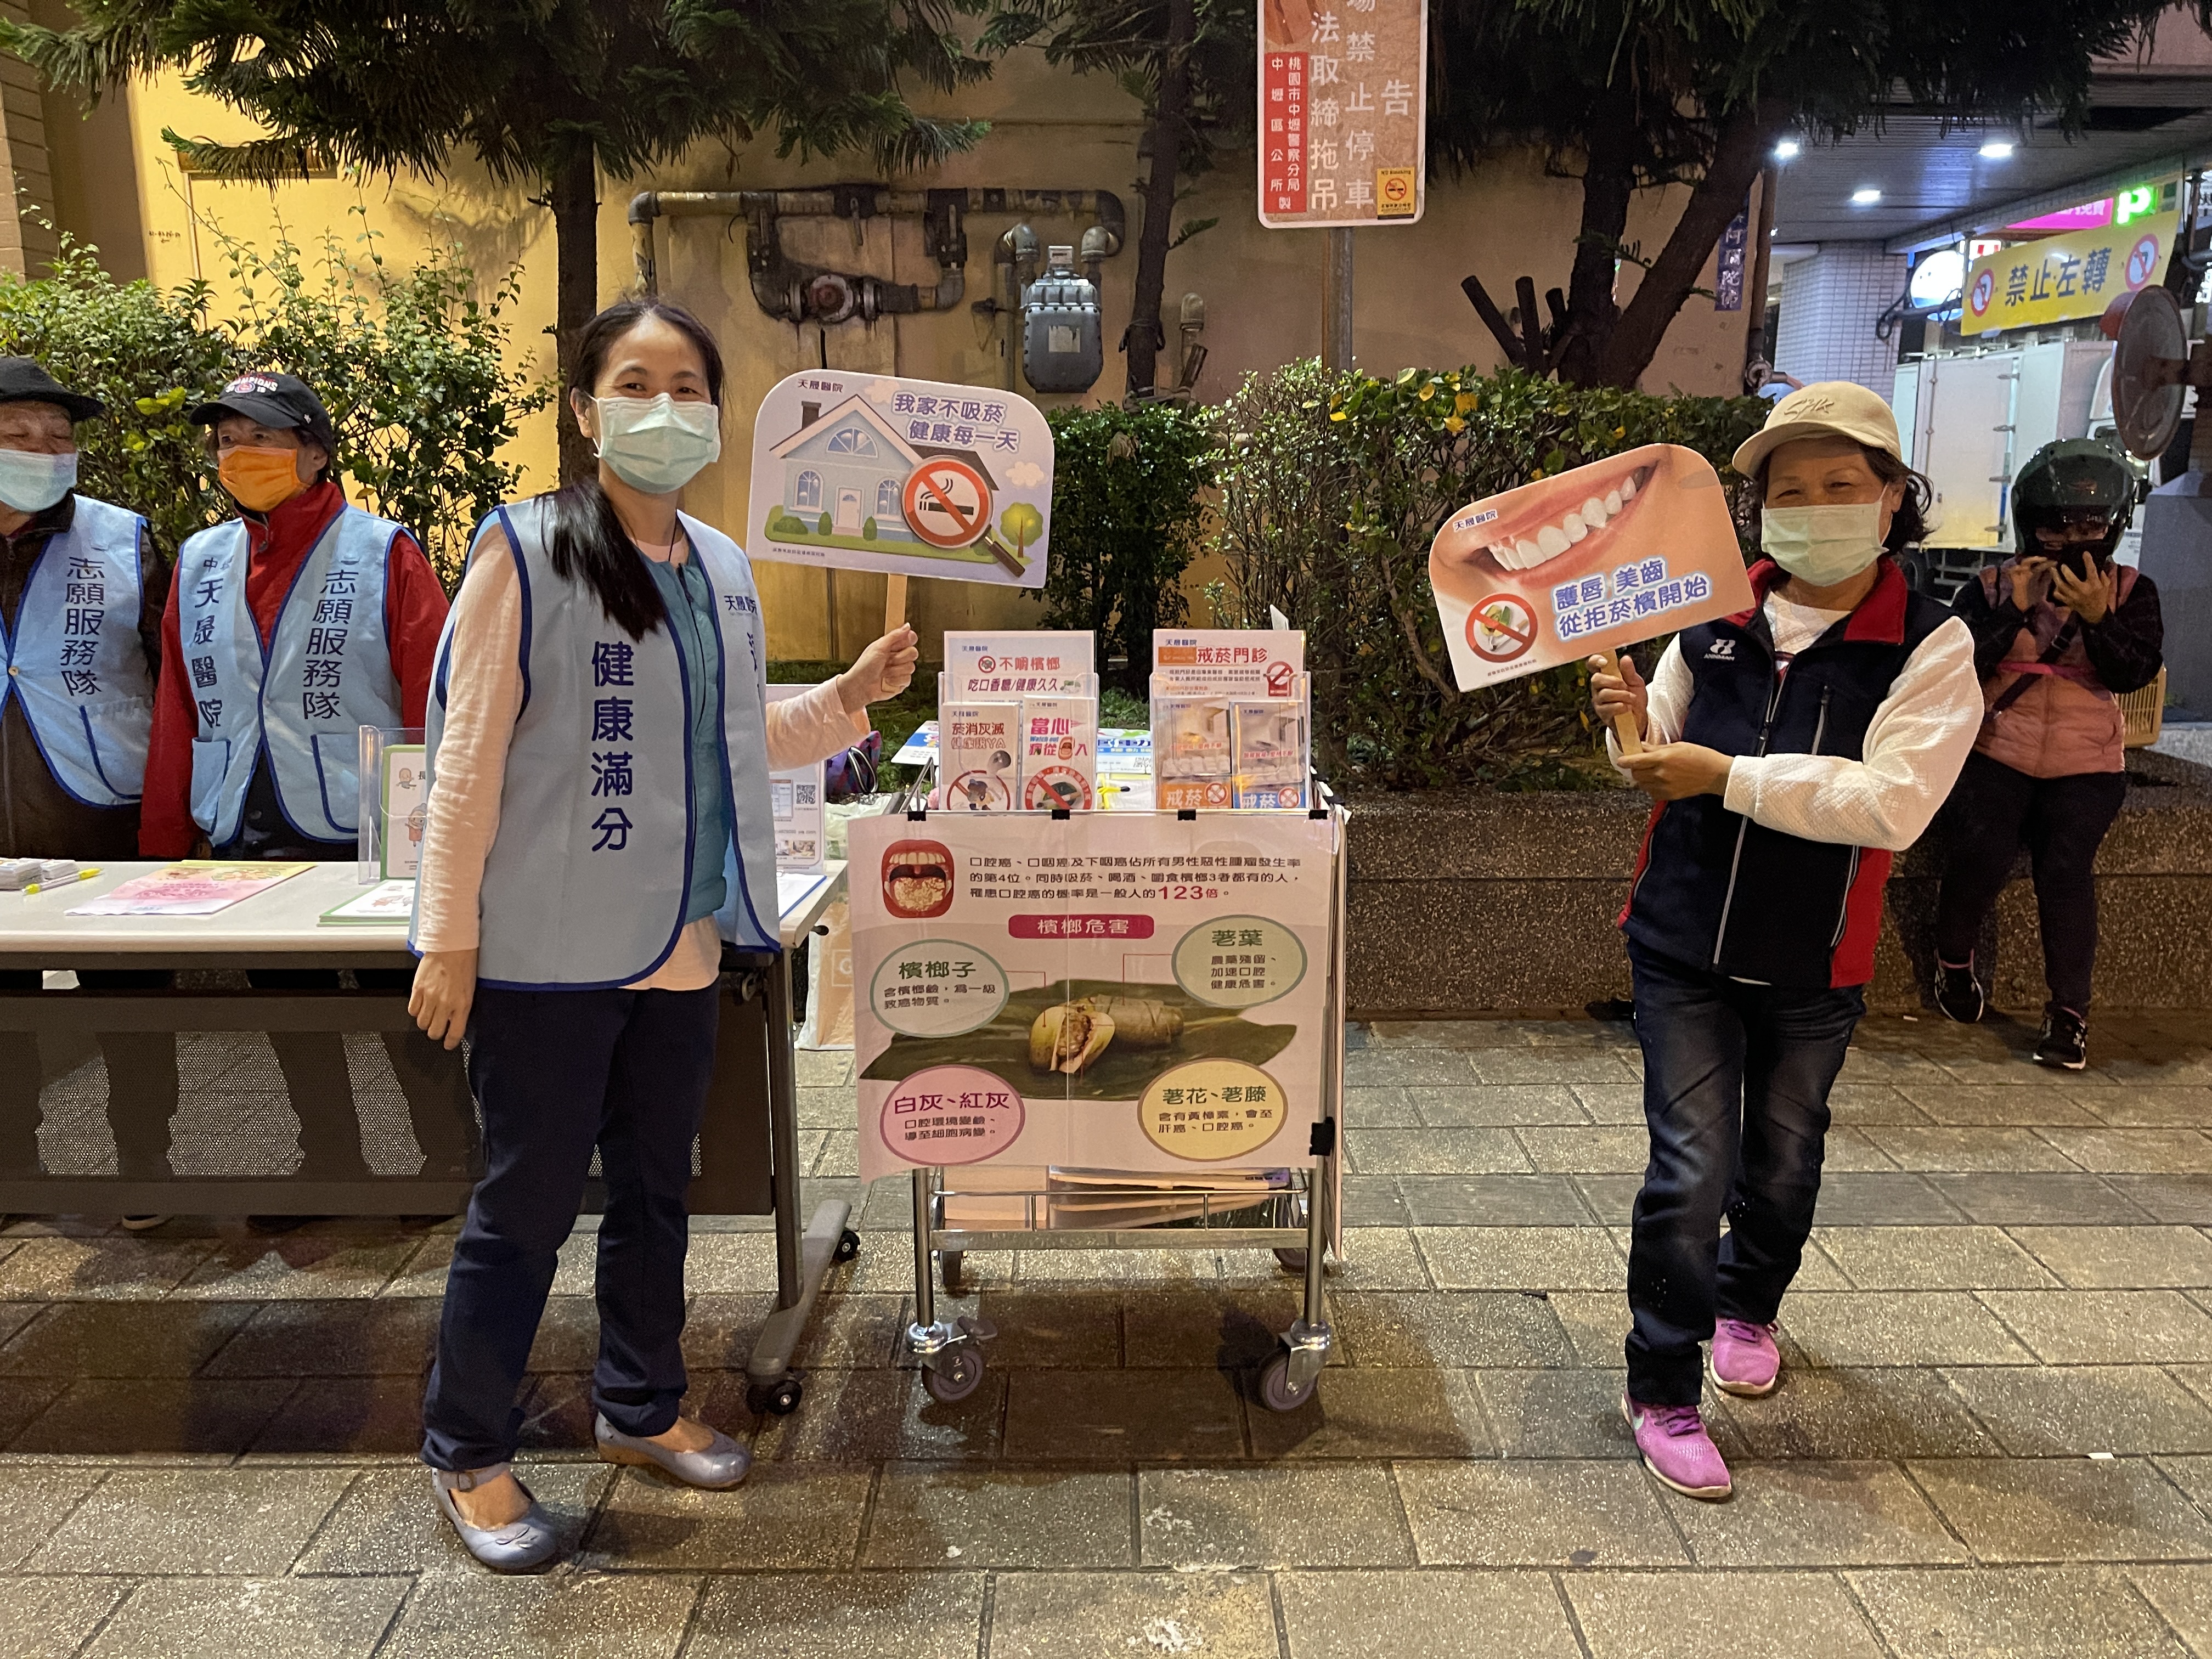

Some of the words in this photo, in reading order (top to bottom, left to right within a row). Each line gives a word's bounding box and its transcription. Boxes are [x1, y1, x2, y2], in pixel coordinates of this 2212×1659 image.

[1310, 11, 1340, 210] 法取締拖吊
[1381, 79, 1413, 115] 告
[1270, 58, 1284, 192] 中壢區公所
[1287, 57, 1301, 192] 桃園市中壢警察分局
[2117, 186, 2152, 225] P
[2004, 247, 2112, 307] 禁止左轉
[798, 379, 843, 393] 天晟醫院
[894, 393, 1006, 424] 我家不吸菸
[909, 420, 1019, 452] 健康每一天
[1453, 509, 1498, 532] 天晟醫院
[1556, 577, 1604, 610] 護唇
[1616, 559, 1664, 590] 美齒
[1560, 577, 1708, 636] 從拒菸檳開始
[60, 556, 105, 697] 志願服務隊
[190, 578, 224, 728] 天晟醫院
[303, 569, 359, 719] 志願服務隊
[1198, 647, 1268, 663] 戒菸門診
[968, 678, 1057, 692] 吃口香糖/健康久久
[952, 722, 1005, 735] 菸消灰滅
[1030, 718, 1071, 735] 當心
[591, 641, 634, 852] 健康滿分
[1166, 788, 1203, 806] 戒菸
[1037, 919, 1130, 935] 檳榔危害
[898, 960, 977, 980] 檳榔子
[894, 1092, 1010, 1115] 白灰、紅灰
